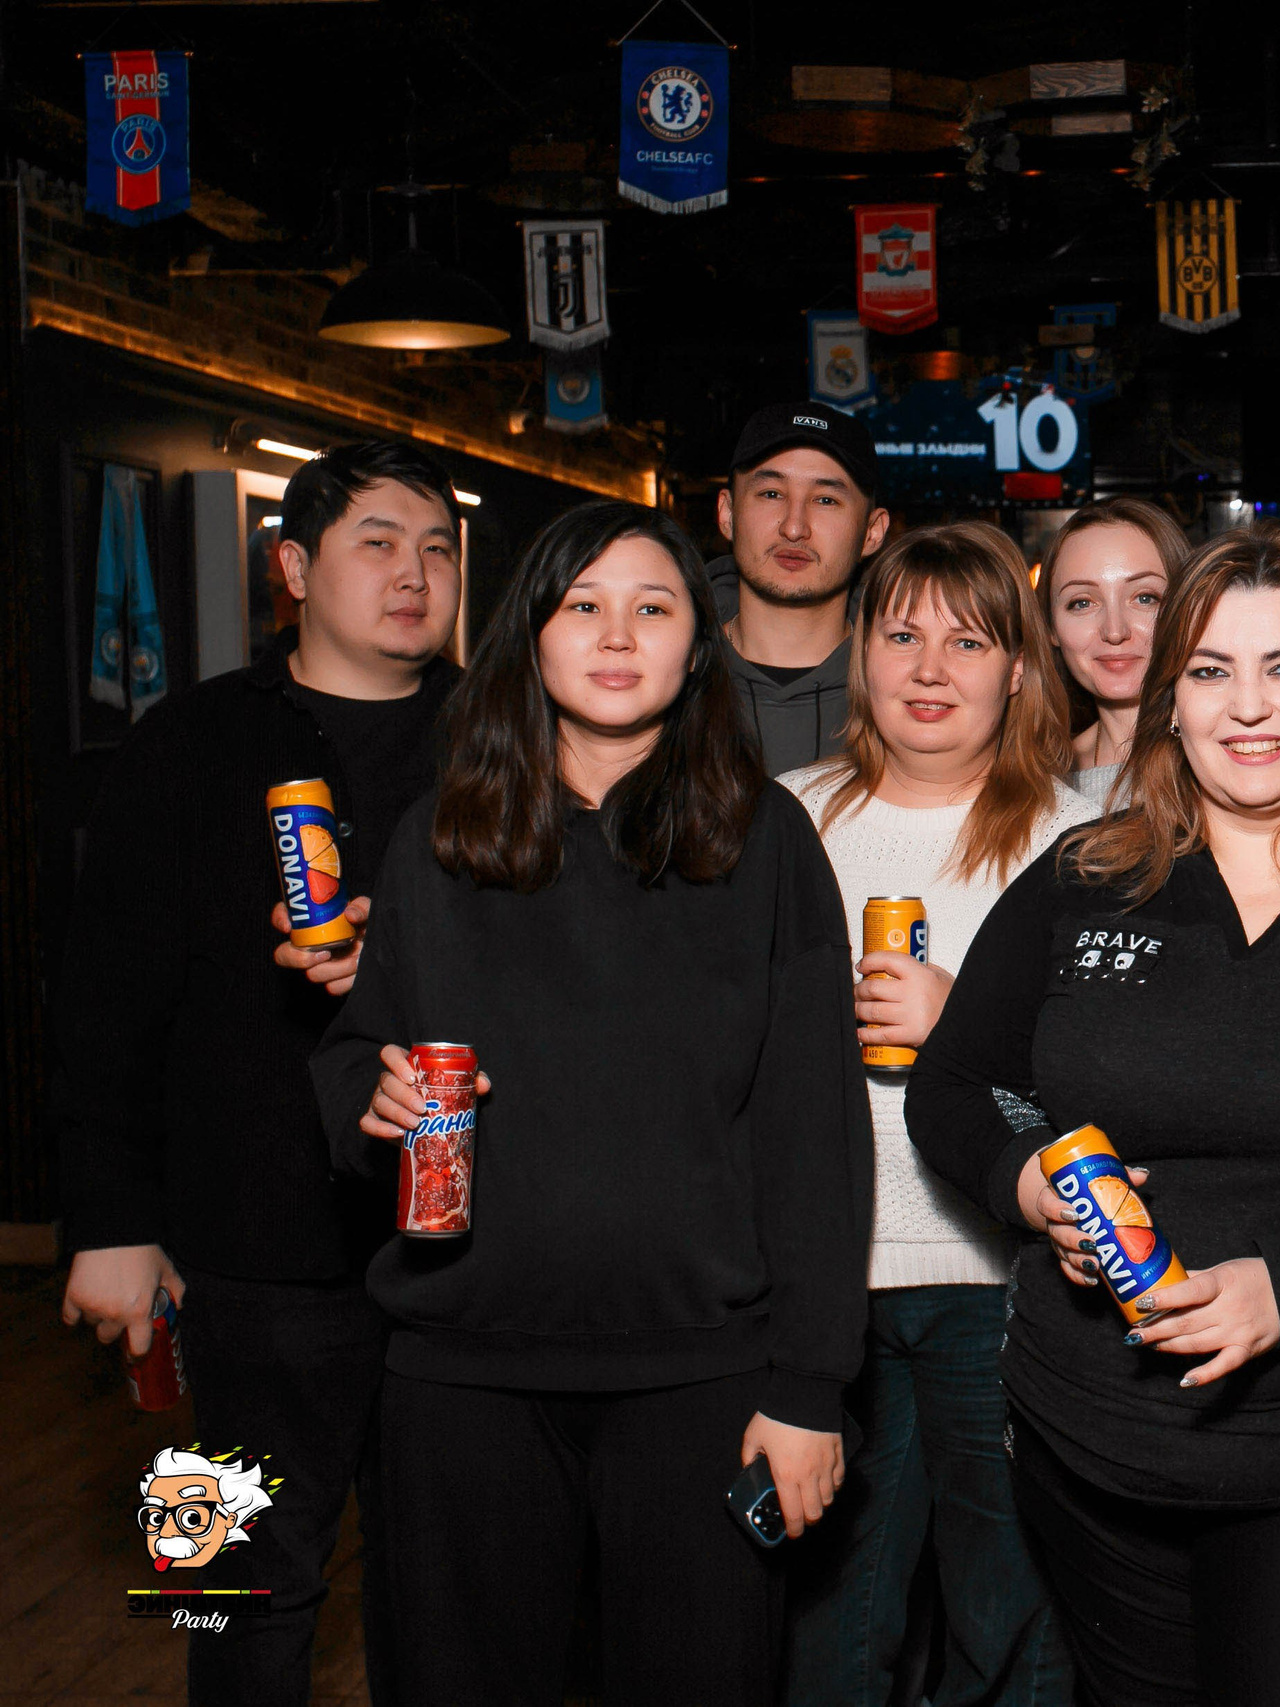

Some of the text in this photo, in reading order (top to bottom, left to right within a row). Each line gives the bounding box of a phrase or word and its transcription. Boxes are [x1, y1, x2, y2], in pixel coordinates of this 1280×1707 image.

[104, 72, 169, 92] PARIS
[651, 68, 701, 88] CHELSEA
[795, 416, 827, 430] VANS
[977, 393, 1079, 472] 10
[274, 813, 310, 922] DONAVI
[1075, 931, 1163, 955] BRAVE
[1056, 1173, 1138, 1294] DONAVI
